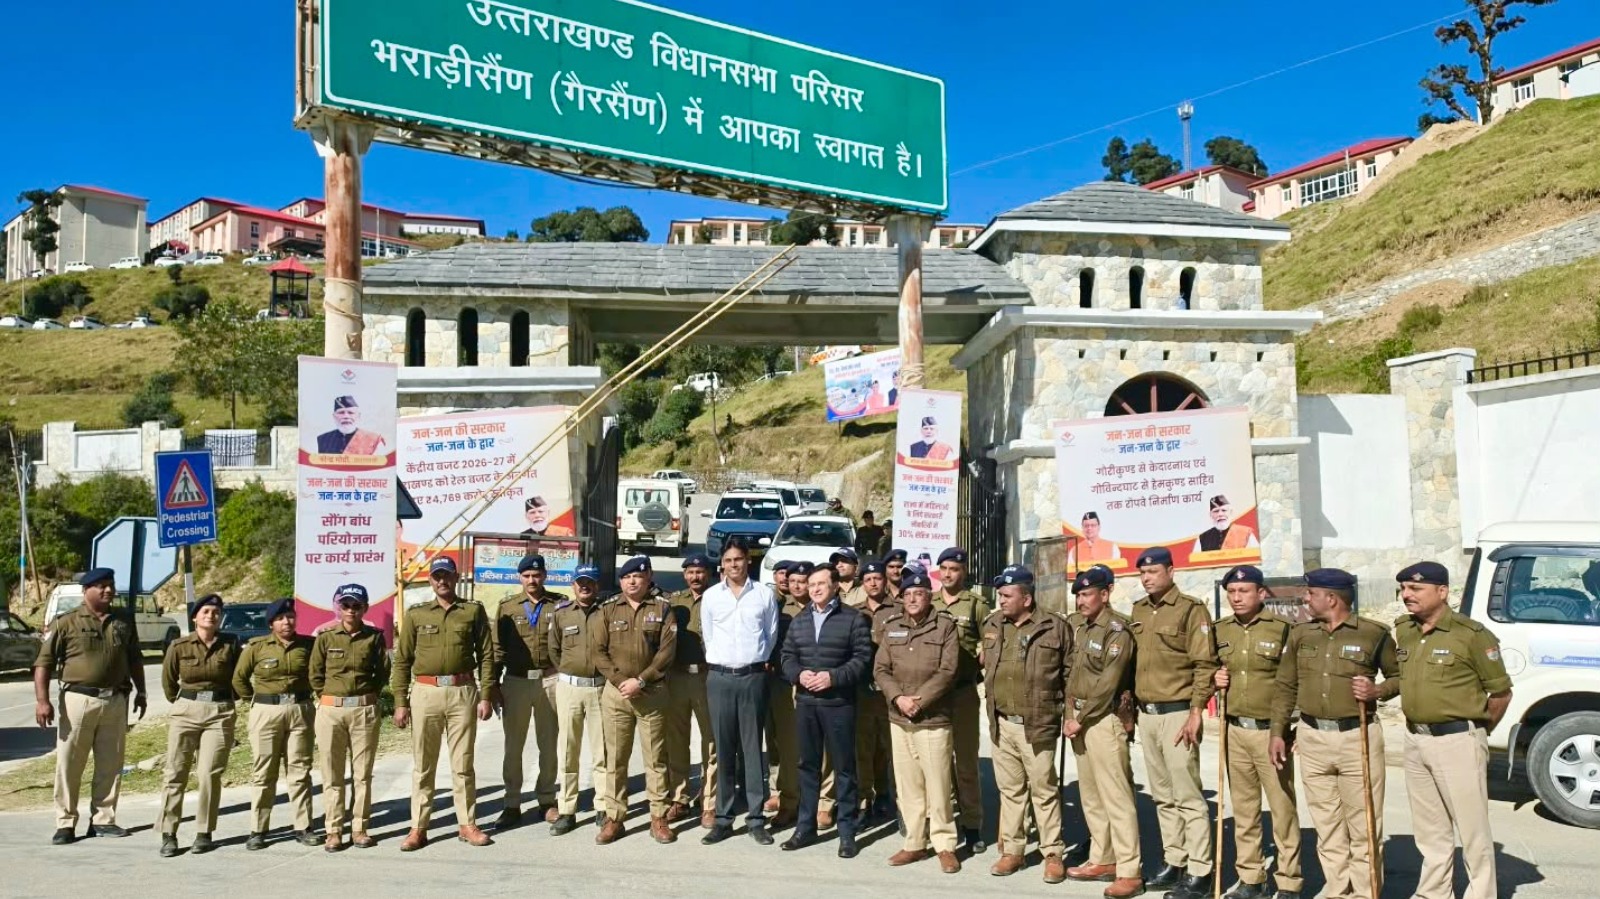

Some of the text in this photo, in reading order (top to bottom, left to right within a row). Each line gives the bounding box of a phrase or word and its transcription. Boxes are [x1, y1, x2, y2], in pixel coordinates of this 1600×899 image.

[466, 0, 864, 112] उत्तराखण्ड विधानसभा परिसर
[371, 39, 922, 178] भराड़ीसैंण (गैरसैंण) में आपका स्वागत है।
[411, 422, 506, 439] जन-जन की सरकार
[1105, 424, 1191, 441] जन-जन की सरकार
[425, 436, 495, 453] जन-जन के द्वार
[1118, 439, 1181, 454] जन-जन के द्वार
[436, 460, 460, 471] बजट
[462, 457, 505, 470] 2026-27
[506, 454, 516, 465] में
[1138, 462, 1146, 473] से
[1148, 459, 1191, 472] केदारनाथ
[1193, 456, 1206, 468] एवं
[306, 475, 388, 488] जन-जन की सरकार
[435, 476, 449, 487] को
[451, 475, 466, 486] रेल
[468, 473, 491, 485] बजट
[1140, 479, 1149, 491] से
[318, 490, 377, 502] जन-जन के द्वार
[1106, 491, 1203, 510] तक रोपवे निर्माण कार्य
[350, 513, 372, 526] बांध
[167, 524, 209, 538] Crossing
[318, 531, 377, 545] परियोजना
[305, 550, 385, 564] पर कार्य प्रारंभ
